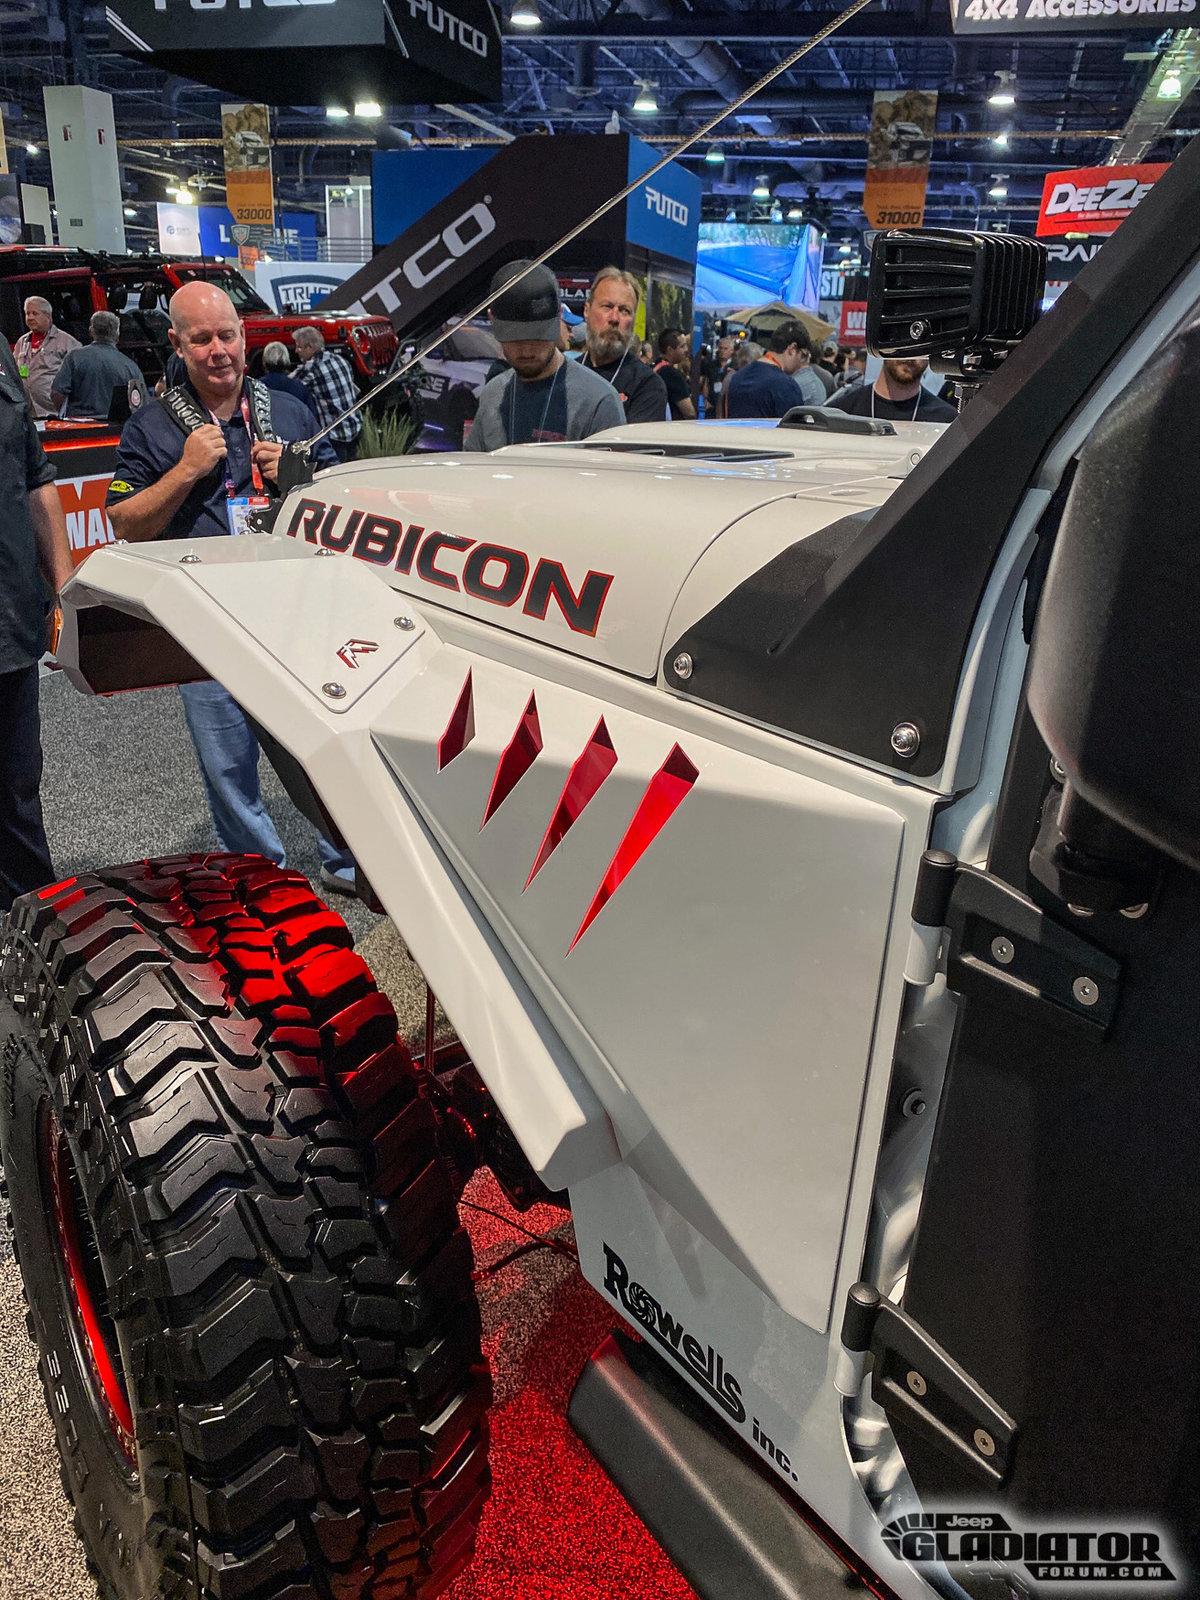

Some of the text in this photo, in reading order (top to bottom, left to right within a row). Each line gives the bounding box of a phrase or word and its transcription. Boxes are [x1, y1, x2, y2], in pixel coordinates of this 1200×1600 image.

[408, 0, 488, 58] PUTCO
[1025, 0, 1197, 18] ACCESSORIES
[237, 208, 272, 220] 33000
[645, 185, 689, 226] PUTCO
[877, 212, 921, 225] 31000
[286, 498, 615, 638] RUBICON
[753, 1416, 799, 1482] inc.
